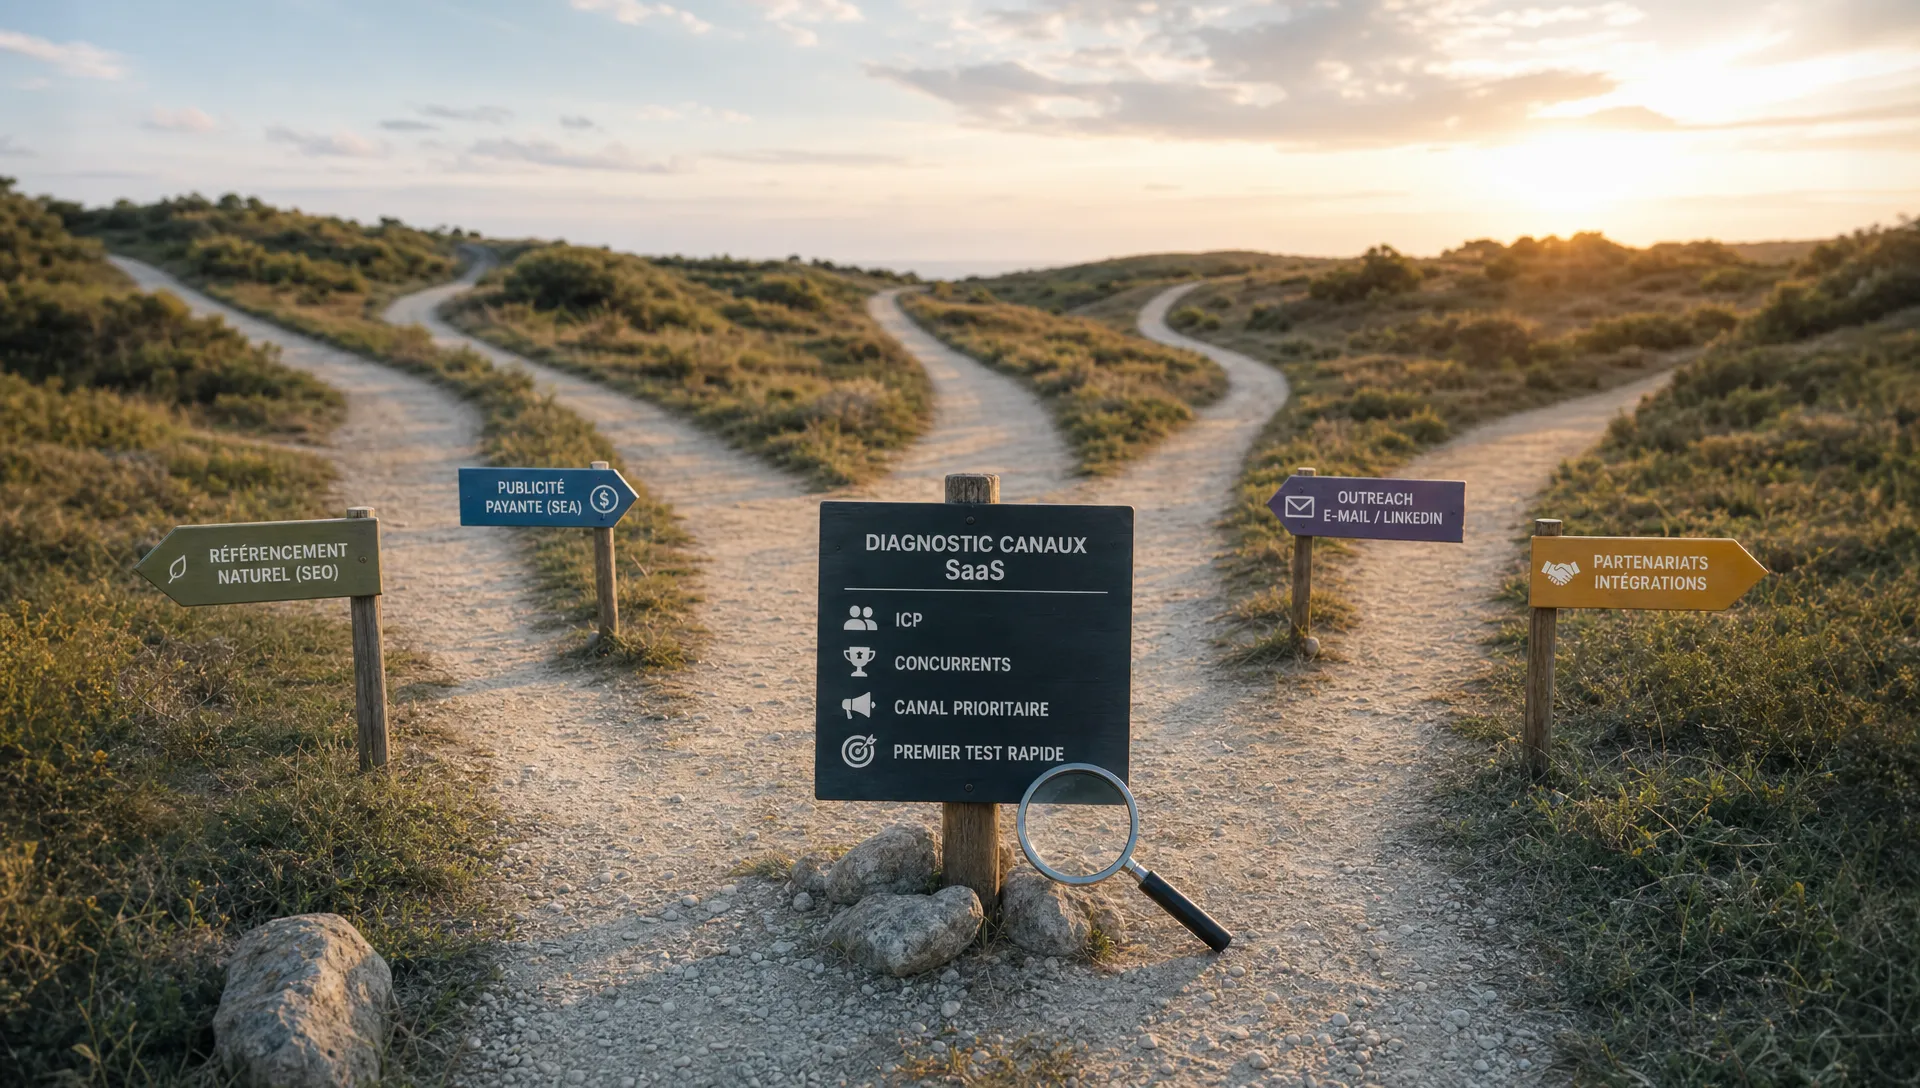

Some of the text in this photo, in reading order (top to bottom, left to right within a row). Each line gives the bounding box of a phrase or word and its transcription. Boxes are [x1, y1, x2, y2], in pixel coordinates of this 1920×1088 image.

[497, 478, 565, 495] PUBLICITÉ
[1337, 490, 1413, 506] OUTREACH
[485, 499, 582, 516] PAYANTE (SEA)
[1322, 508, 1370, 524] E-MAIL
[1382, 510, 1444, 526] LINKEDIN
[865, 533, 1087, 554] DIAGNOSTIC CANAUX
[209, 542, 349, 565] RÉFÉRENCEMENT
[945, 558, 1005, 581] SaaS
[1593, 554, 1709, 572] PARTENARIATS
[218, 563, 339, 585] NATUREL (SEO)
[1593, 570, 1708, 592] INTÉGRATIONS
[895, 612, 923, 628] ICP
[894, 655, 1011, 672] CONCURRENTS
[894, 699, 1049, 717] CANAL PRIORITAIRE
[893, 744, 1065, 762] PREMIER TEST RAPIDE
